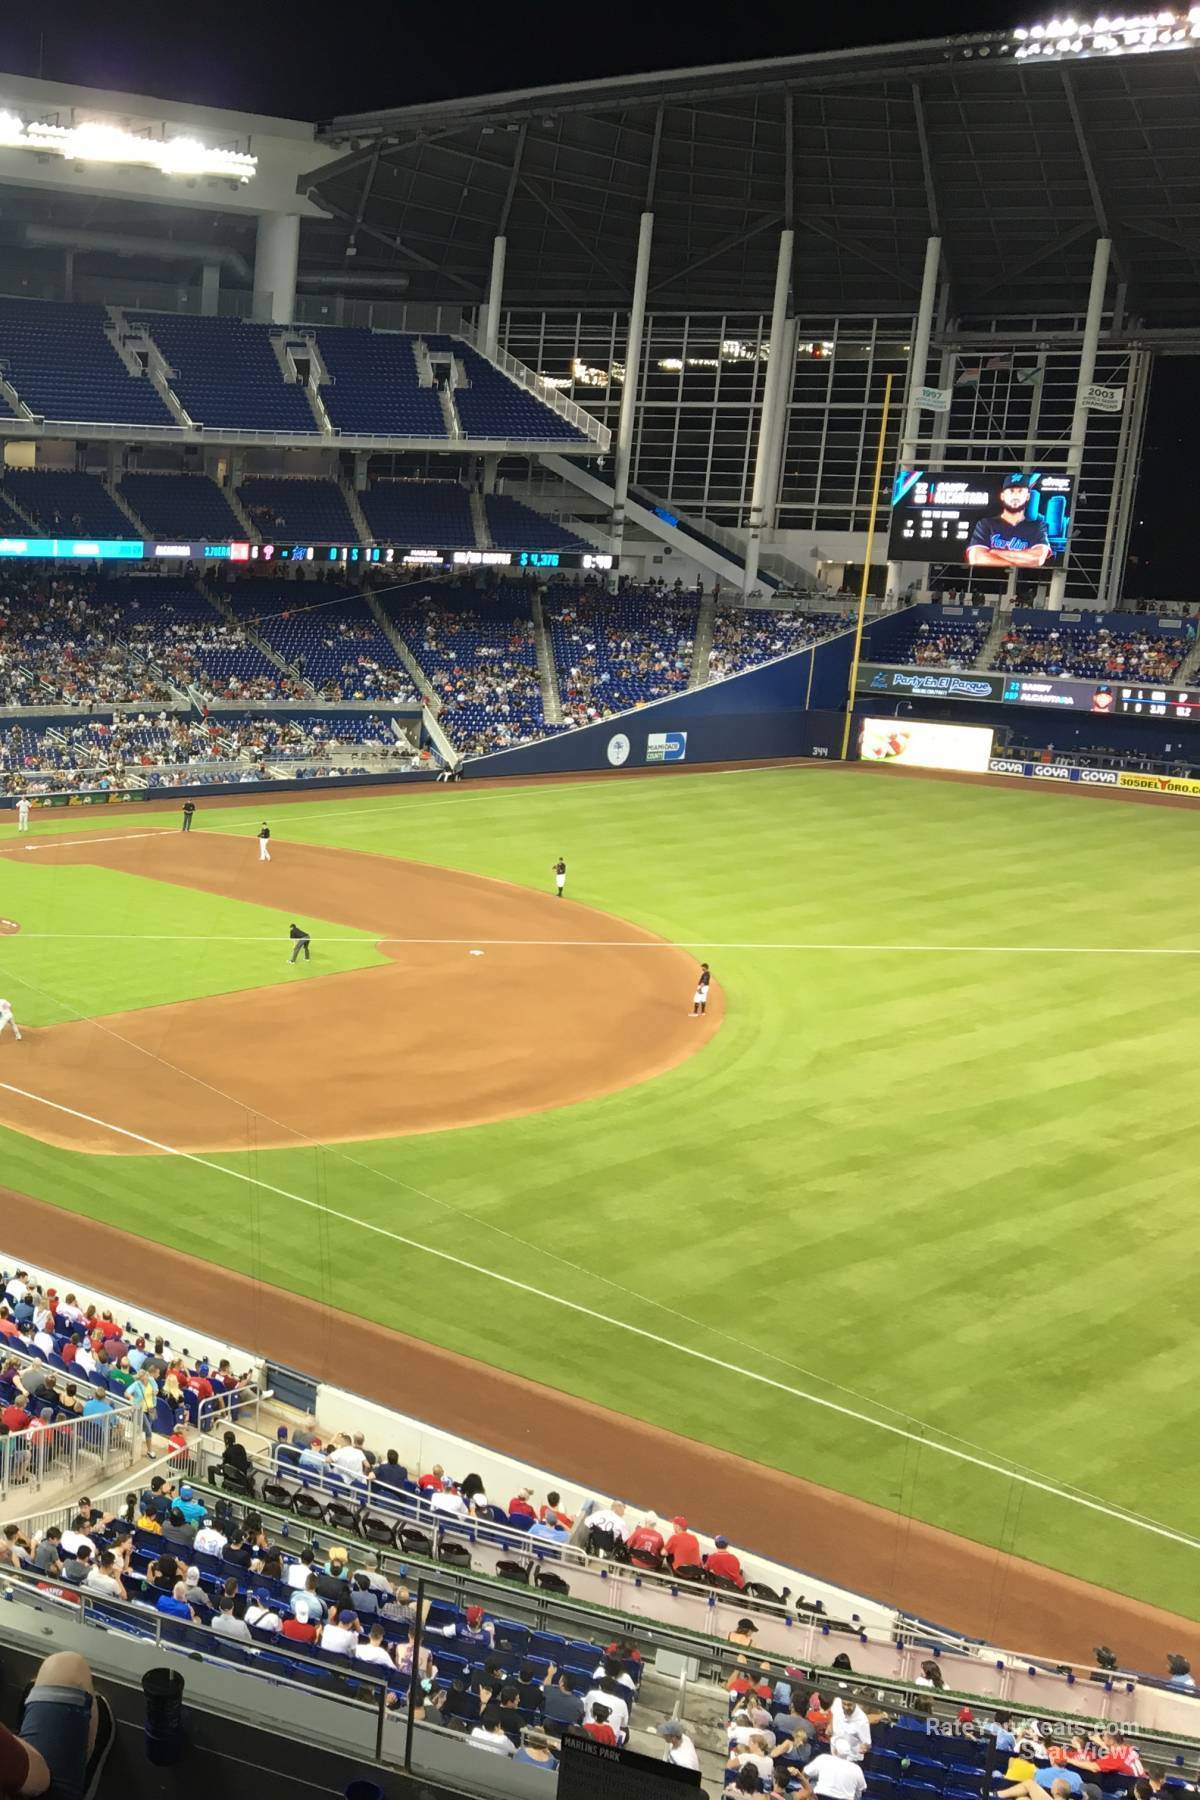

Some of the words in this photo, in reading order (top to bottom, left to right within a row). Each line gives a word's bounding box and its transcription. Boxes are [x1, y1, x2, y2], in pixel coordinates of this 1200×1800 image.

[1088, 388, 1114, 399] 2003
[386, 549, 394, 562] 2
[520, 553, 528, 566] $
[892, 674, 923, 687] Party
[924, 676, 937, 687] En
[938, 677, 950, 688] El
[950, 678, 990, 692] Parque
[1011, 682, 1020, 690] 22
[812, 746, 828, 756] 344
[990, 761, 1023, 773] GOYA
[1035, 766, 1069, 778] GOYA
[1081, 771, 1116, 783] GOYA
[564, 1737, 598, 1755] MARLINS
[599, 1748, 621, 1763] PARK
